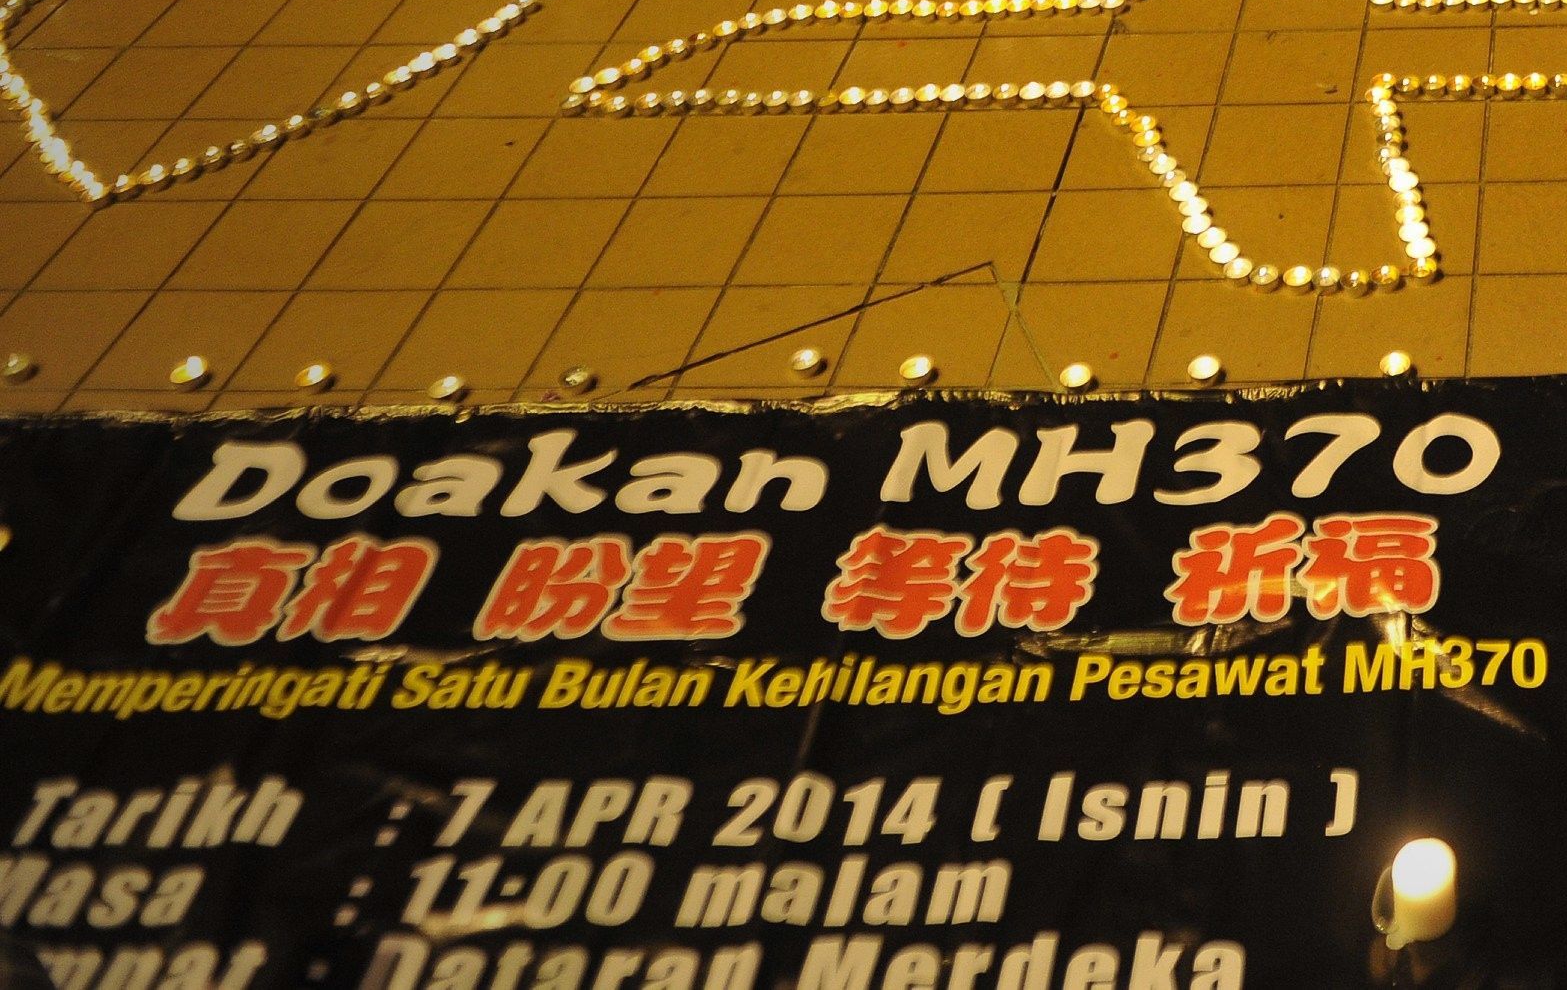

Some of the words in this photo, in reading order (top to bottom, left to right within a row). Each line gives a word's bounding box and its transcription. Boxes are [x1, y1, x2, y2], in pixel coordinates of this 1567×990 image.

[171, 428, 829, 522] Doakan
[879, 412, 1502, 510] MH370
[146, 531, 438, 646] 真相
[471, 529, 772, 644] 盼望
[821, 524, 1100, 640] 等待
[1165, 512, 1441, 625] 祈福
[0, 655, 390, 722] Memperingati
[392, 663, 530, 712] Satu
[538, 663, 712, 710] Bulan
[722, 650, 1053, 718] Kehilangan
[1070, 650, 1325, 702] Pesawat
[1340, 635, 1555, 698] MH370
[8, 774, 305, 850] Tarikh
[435, 779, 496, 848] 7
[500, 775, 693, 848] APR
[711, 771, 942, 848] 2014
[1037, 770, 1290, 843] Isnin
[400, 852, 655, 928] 11:00
[674, 854, 1012, 928] malam
[358, 928, 780, 990] Dataran
[792, 930, 1248, 990] Merdeka
